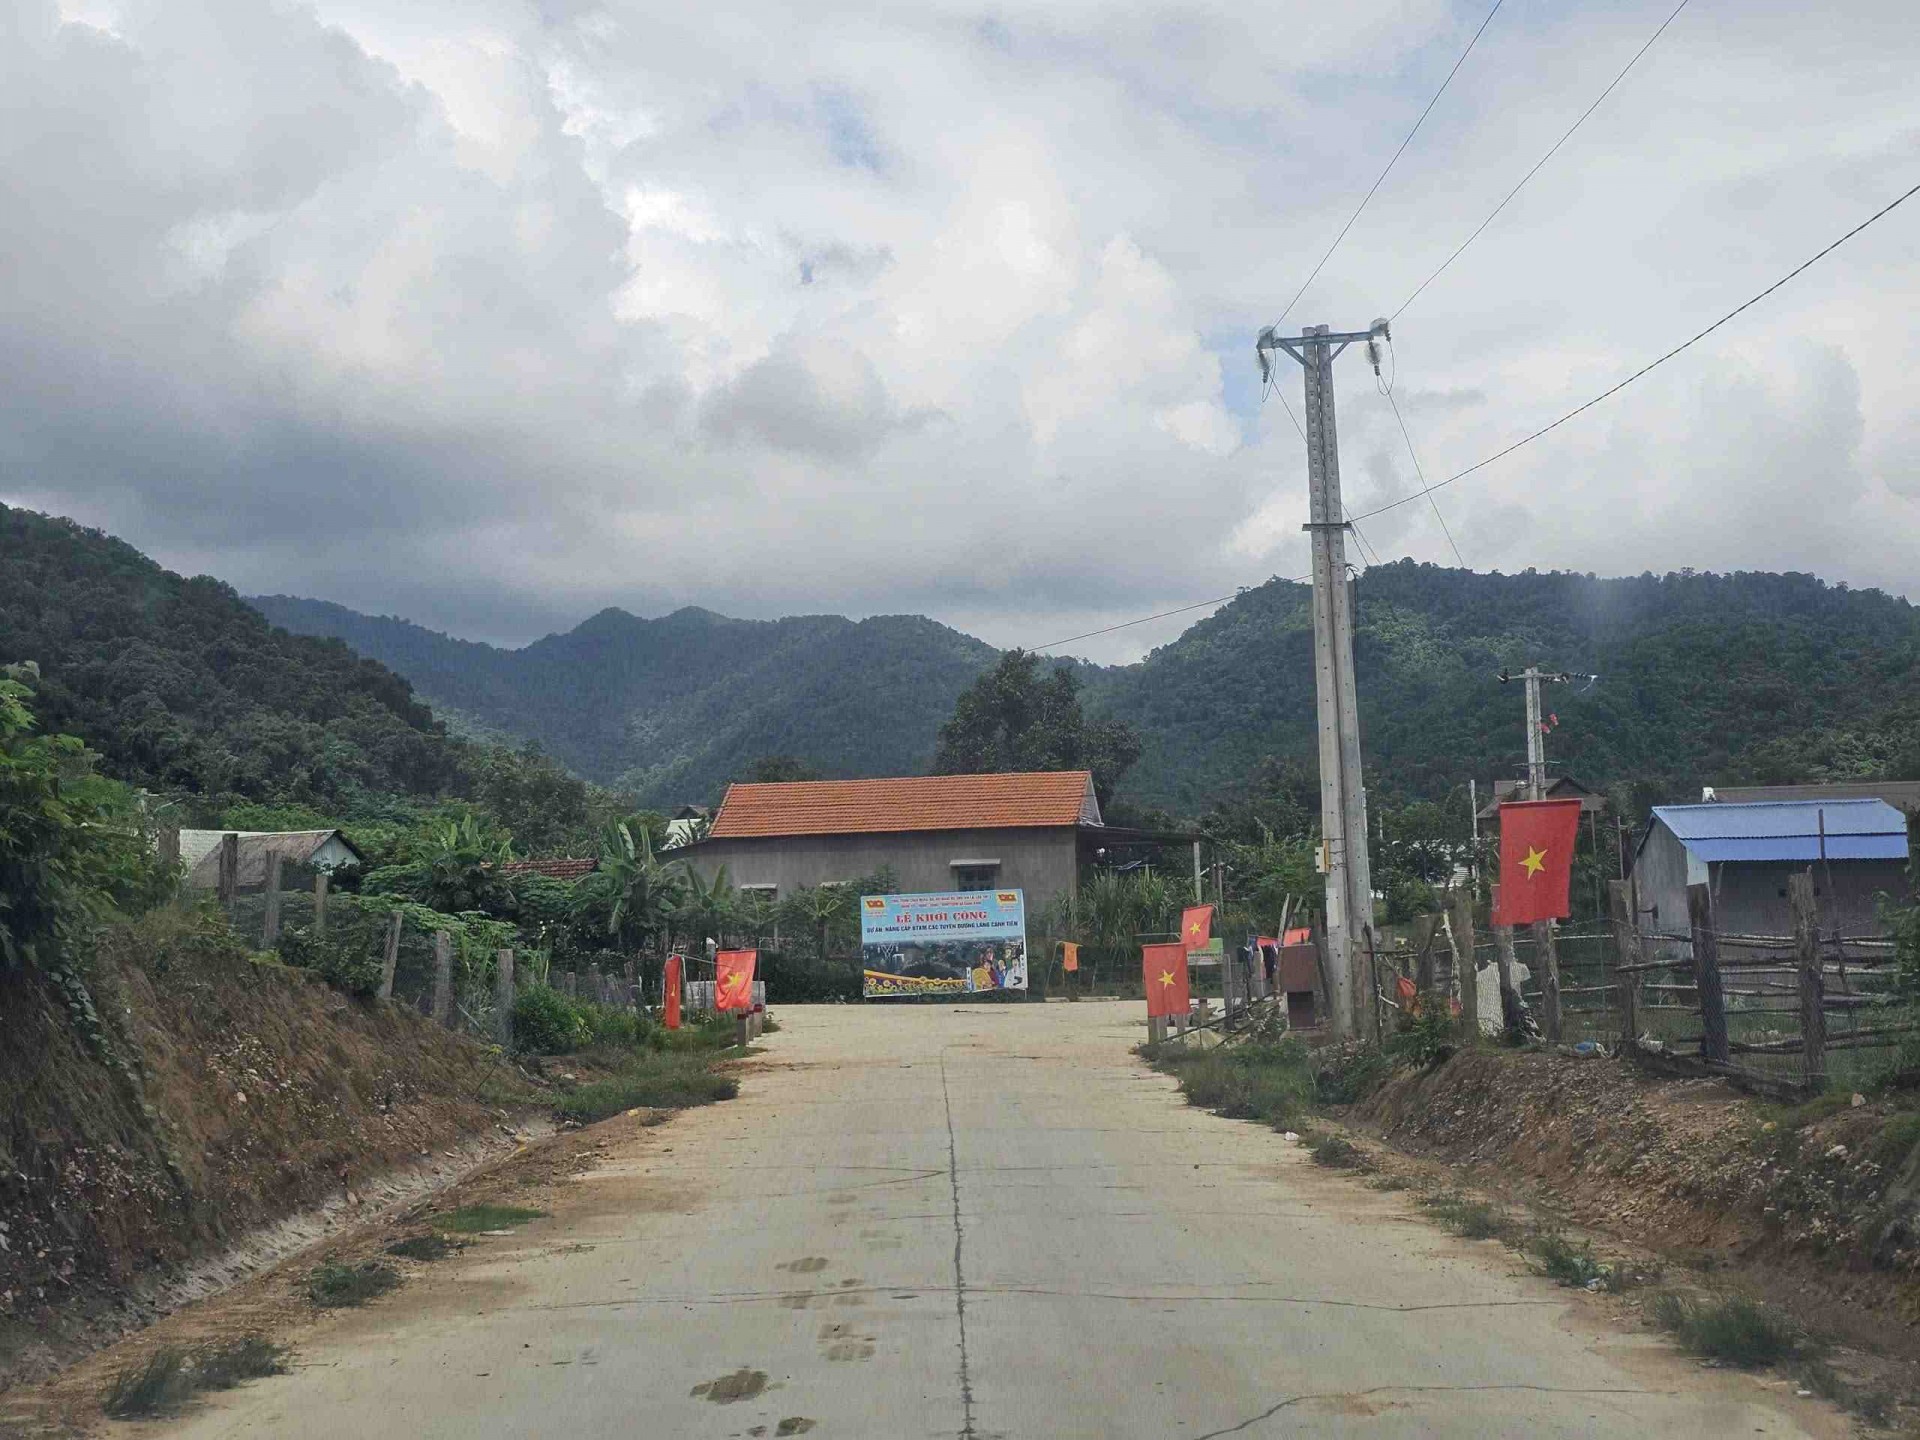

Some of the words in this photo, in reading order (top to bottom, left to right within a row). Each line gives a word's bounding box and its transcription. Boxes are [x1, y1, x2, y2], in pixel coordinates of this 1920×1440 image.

[896, 911, 912, 923] LỄ
[916, 911, 948, 922] KHỞI
[953, 909, 987, 921] CÔNG
